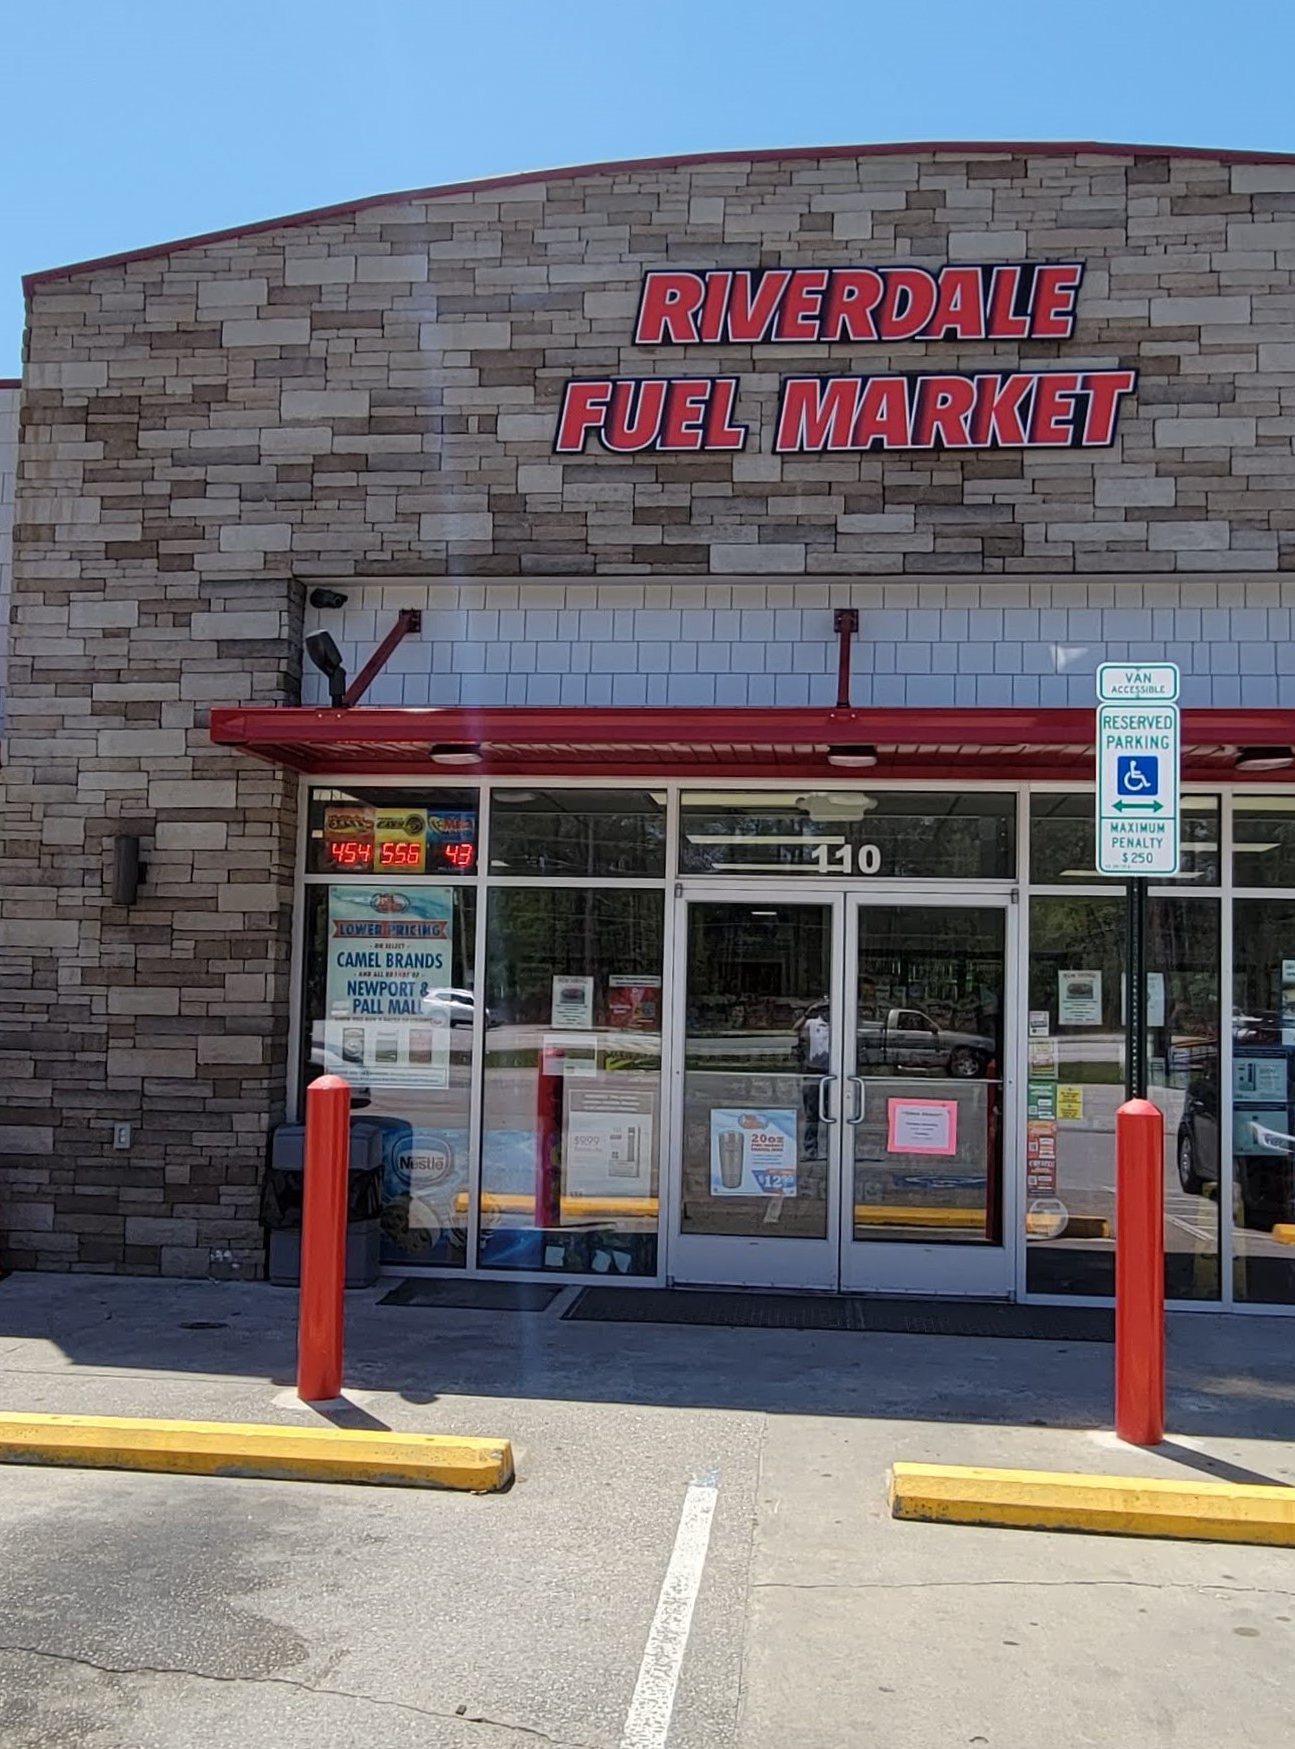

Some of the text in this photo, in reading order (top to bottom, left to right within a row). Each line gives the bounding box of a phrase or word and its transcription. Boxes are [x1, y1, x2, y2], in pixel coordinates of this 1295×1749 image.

[635, 264, 1082, 343] RIVERDALE
[555, 369, 1137, 452] FUEL MARKET
[1125, 673, 1152, 684] VAN
[1111, 685, 1166, 694] ACCESSIBLE
[1103, 715, 1173, 730] RESERVED
[1106, 735, 1170, 750] PARKING
[1110, 822, 1165, 834] MAXIMUM
[1111, 837, 1164, 849] PENALTY
[332, 843, 371, 863] 454
[446, 844, 472, 865] 43
[811, 844, 881, 874] 110
[1121, 852, 1154, 864] $250
[340, 923, 440, 936] LOWER PRICING
[337, 951, 443, 969] CAMEL BRANDS
[347, 980, 416, 997] NEWPORT
[353, 998, 423, 1015] PALL MALL
